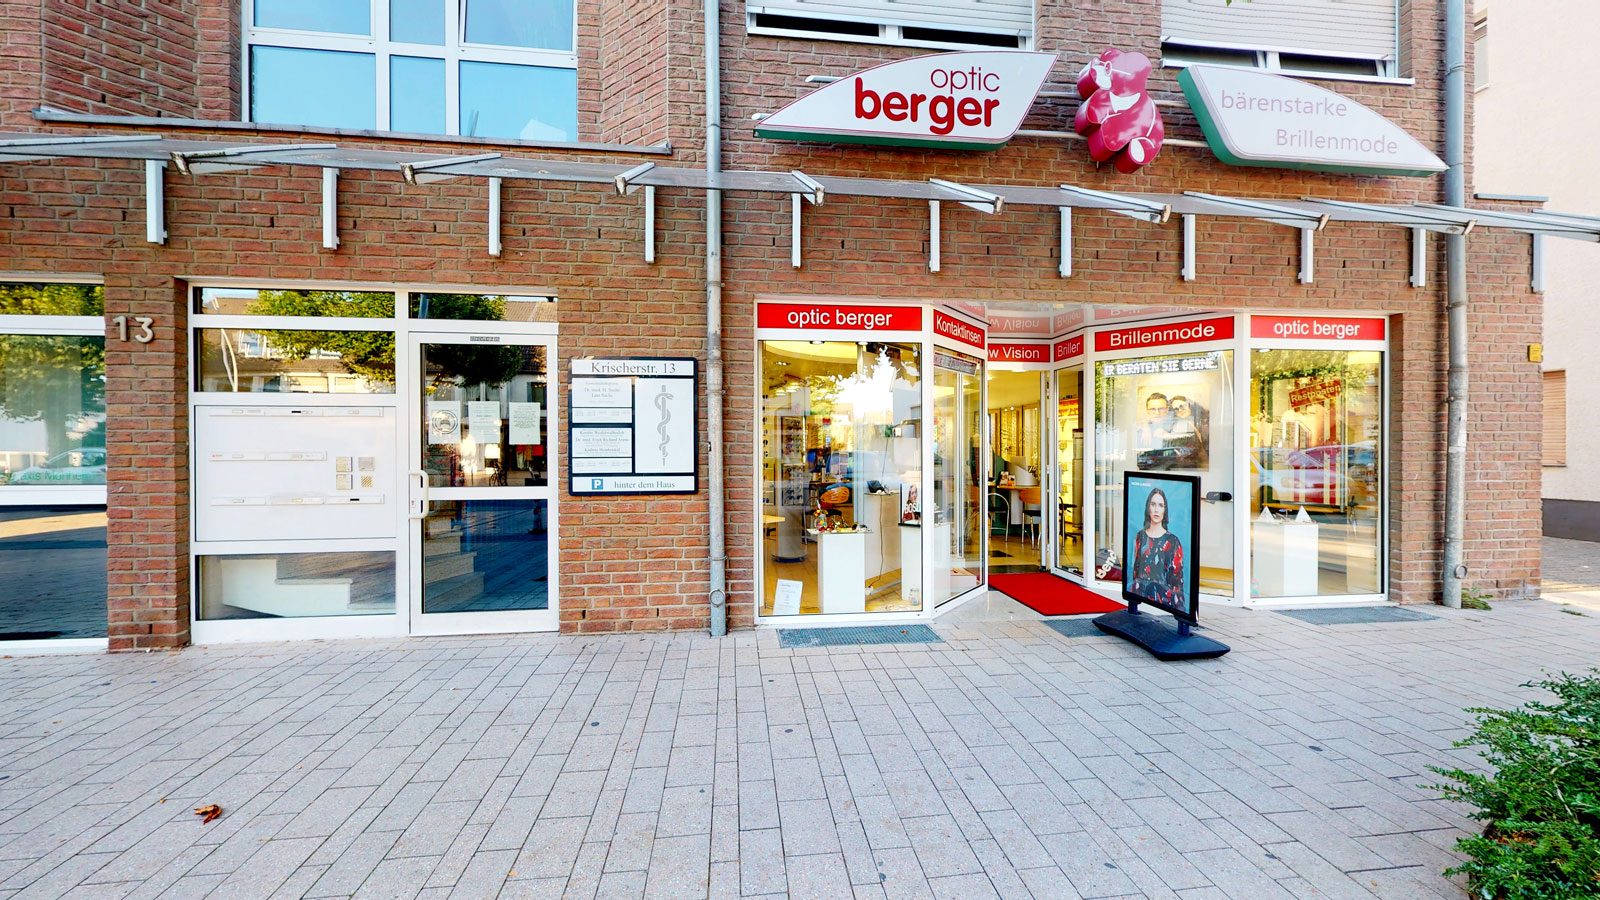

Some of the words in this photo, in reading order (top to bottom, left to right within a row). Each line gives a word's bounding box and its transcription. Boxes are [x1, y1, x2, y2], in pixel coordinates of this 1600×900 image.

[930, 66, 1000, 94] optic
[854, 76, 1000, 135] berger
[1221, 89, 1347, 116] bärenstarke
[1276, 128, 1398, 154] Brillenmode
[112, 315, 154, 343] 13
[787, 309, 831, 327] optic
[835, 307, 893, 329] berger
[935, 314, 982, 345] Kontaktlinsen
[1273, 320, 1310, 337] optic
[1312, 320, 1361, 339] berger
[1110, 323, 1216, 347] Brillenmode
[988, 348, 1000, 359] w
[1002, 346, 1040, 359] Vision
[591, 362, 658, 374] Krischerstr.
[663, 363, 676, 374] 13
[1117, 361, 1160, 375] BERATEN
[1161, 360, 1180, 372] SIE
[1291, 384, 1342, 403] Restposten
[614, 481, 636, 489] hinter
[638, 481, 655, 489] dem
[656, 481, 675, 489] Haus
